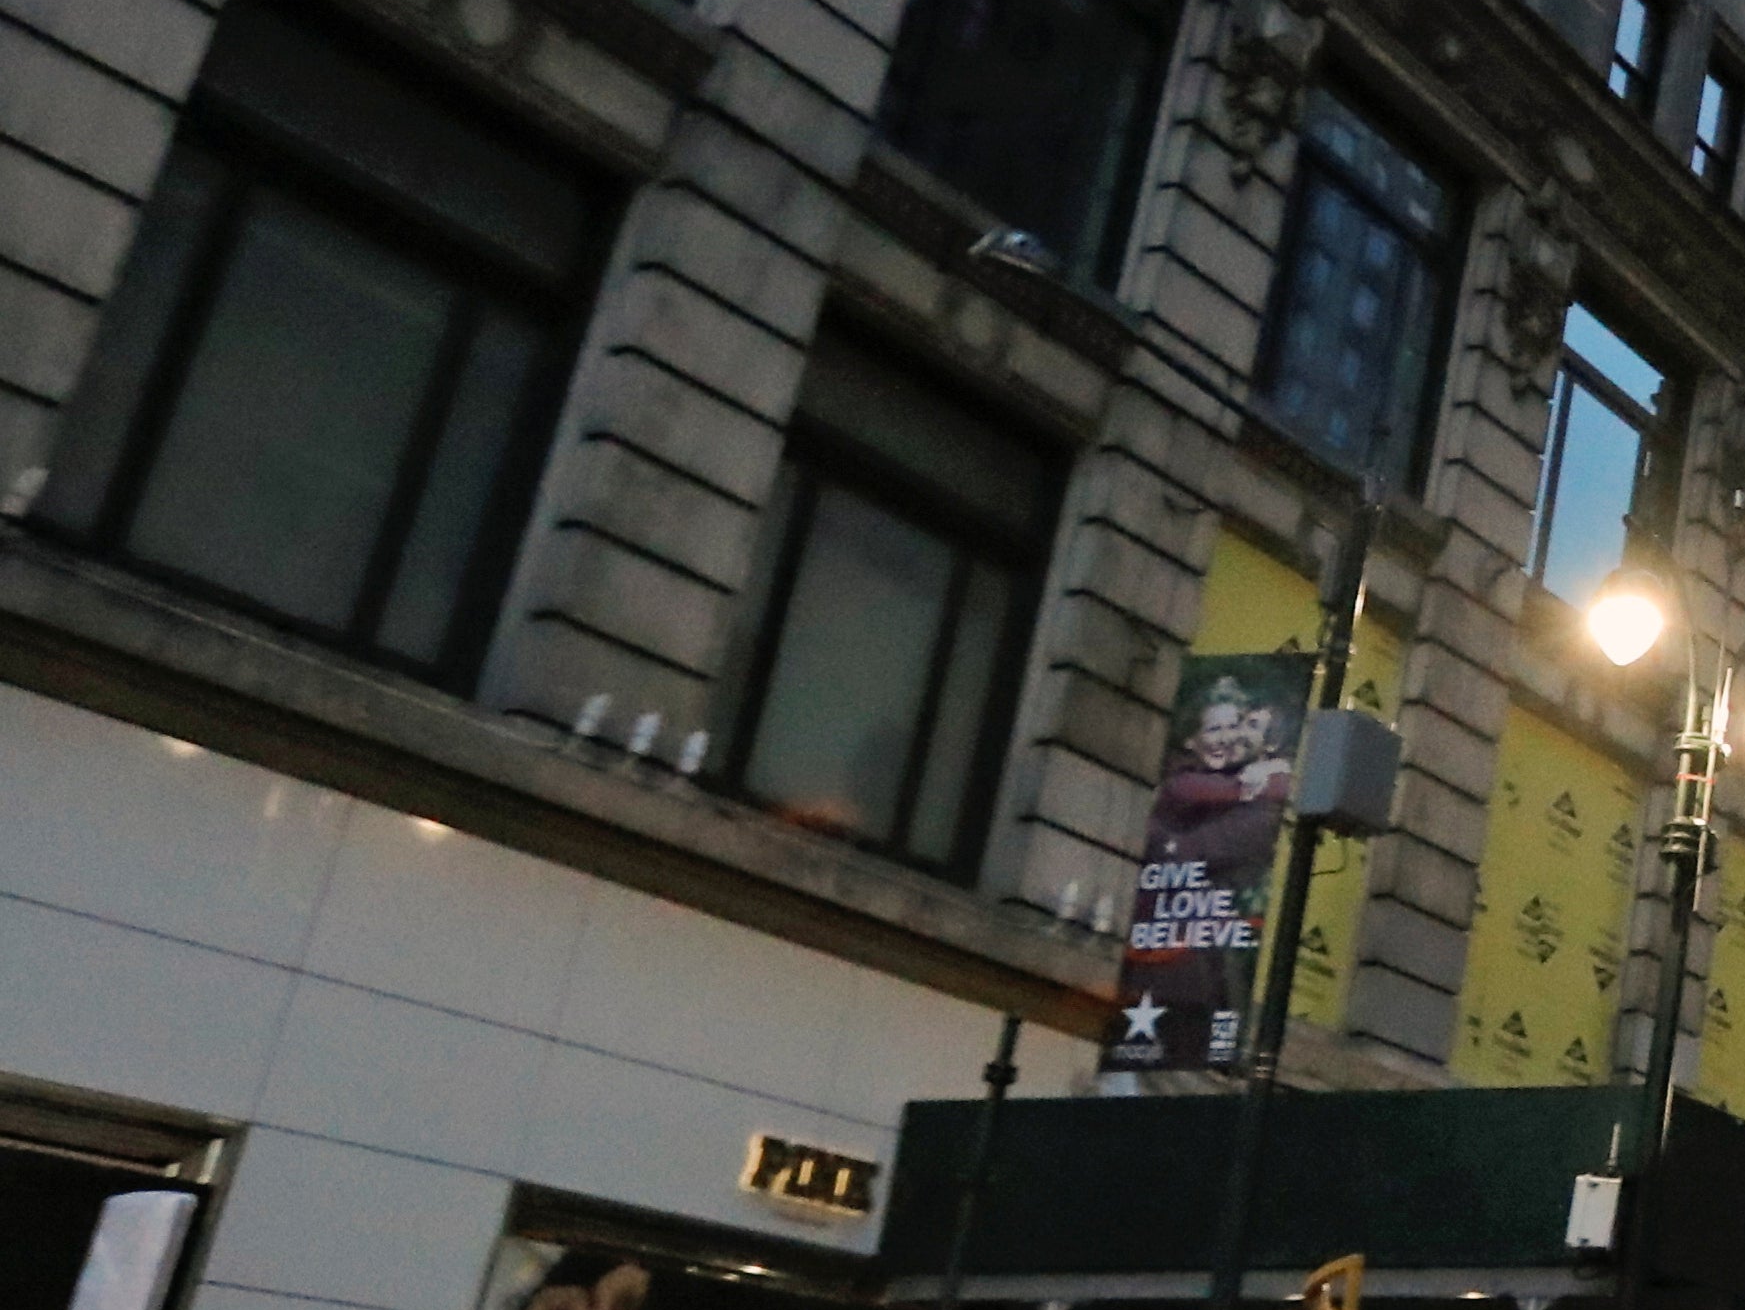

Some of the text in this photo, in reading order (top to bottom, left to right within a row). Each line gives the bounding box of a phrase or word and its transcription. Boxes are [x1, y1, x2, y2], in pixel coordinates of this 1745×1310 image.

[1140, 861, 1212, 890] GIVE.
[1153, 890, 1239, 920] LOVE.
[1130, 920, 1259, 950] BELIEVE.
[746, 1134, 882, 1216] PINK
